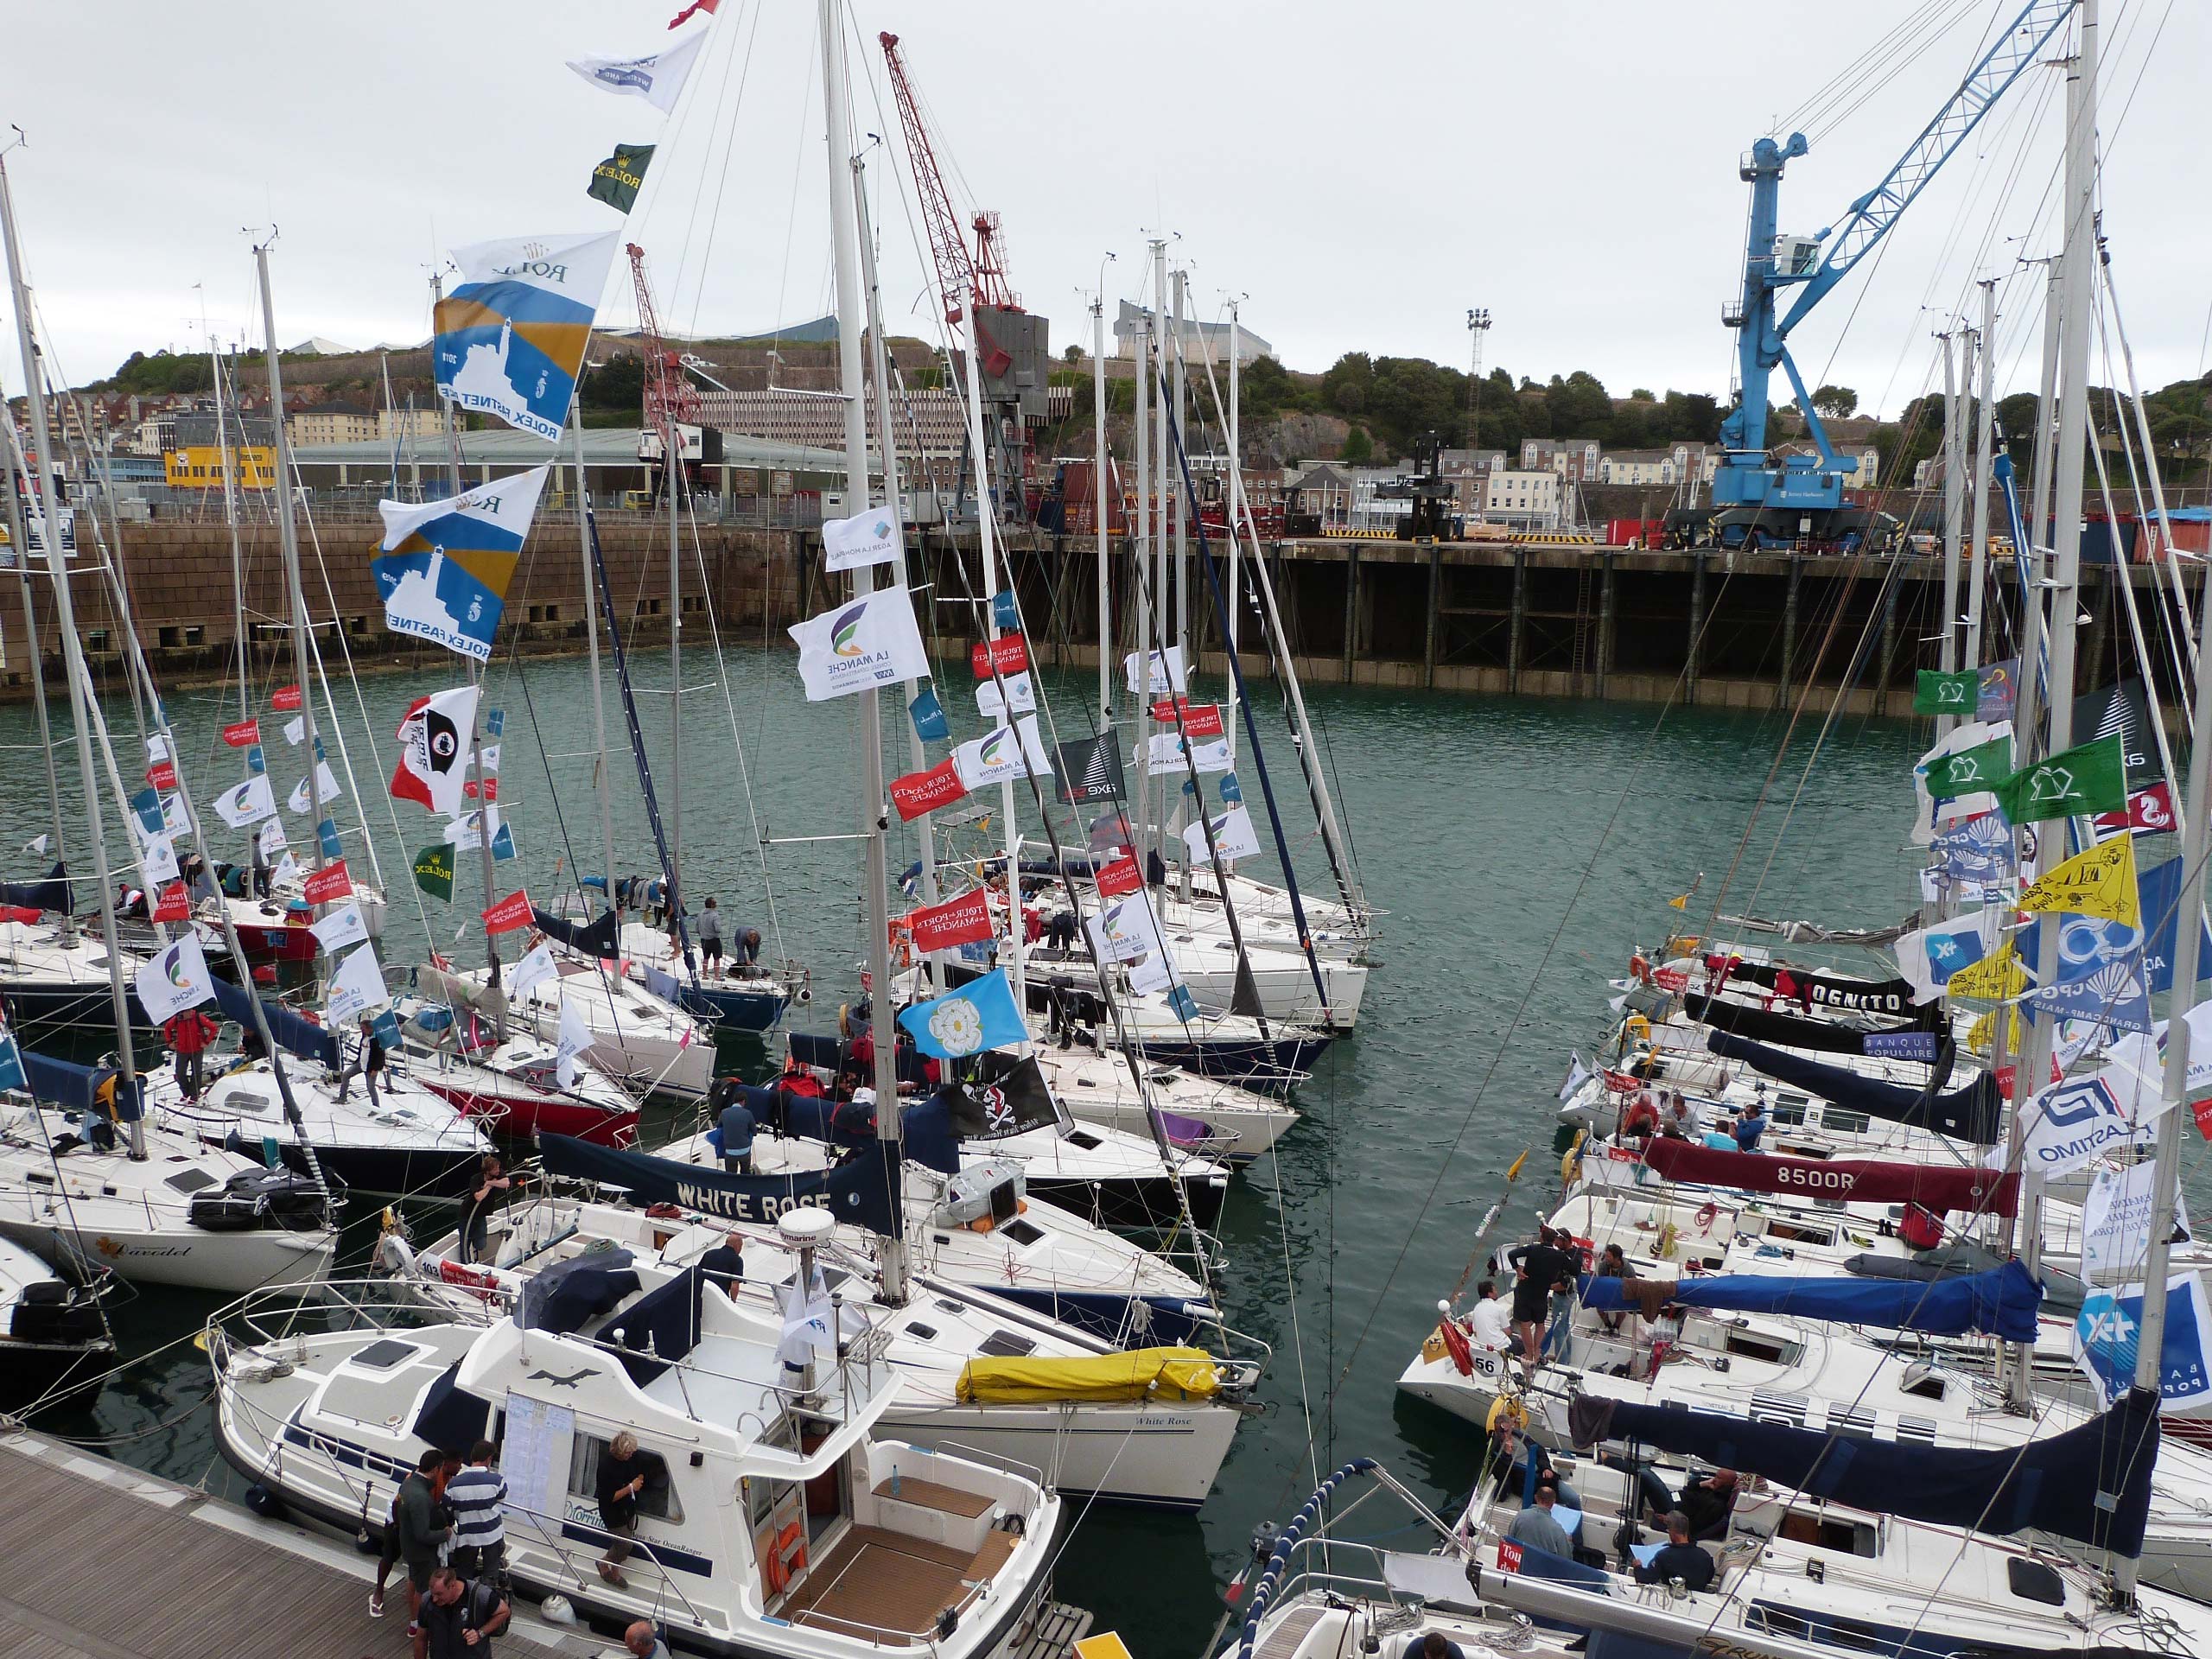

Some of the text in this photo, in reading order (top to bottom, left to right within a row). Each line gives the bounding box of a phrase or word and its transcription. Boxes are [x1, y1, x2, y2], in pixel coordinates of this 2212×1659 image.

[1813, 984, 1900, 1011] OGNITO
[1866, 1038, 1933, 1047] BANQUE
[1866, 1049, 1933, 1058] POPULAIRE
[1777, 1166, 1854, 1190] 8500R
[677, 1181, 831, 1221] WHITE ROSE
[422, 1262, 439, 1277] 103
[1475, 1358, 1495, 1373] 56
[1135, 1416, 1192, 1426] White Rose
[648, 1535, 662, 1545] Star
[1503, 1543, 1522, 1561] Tou
